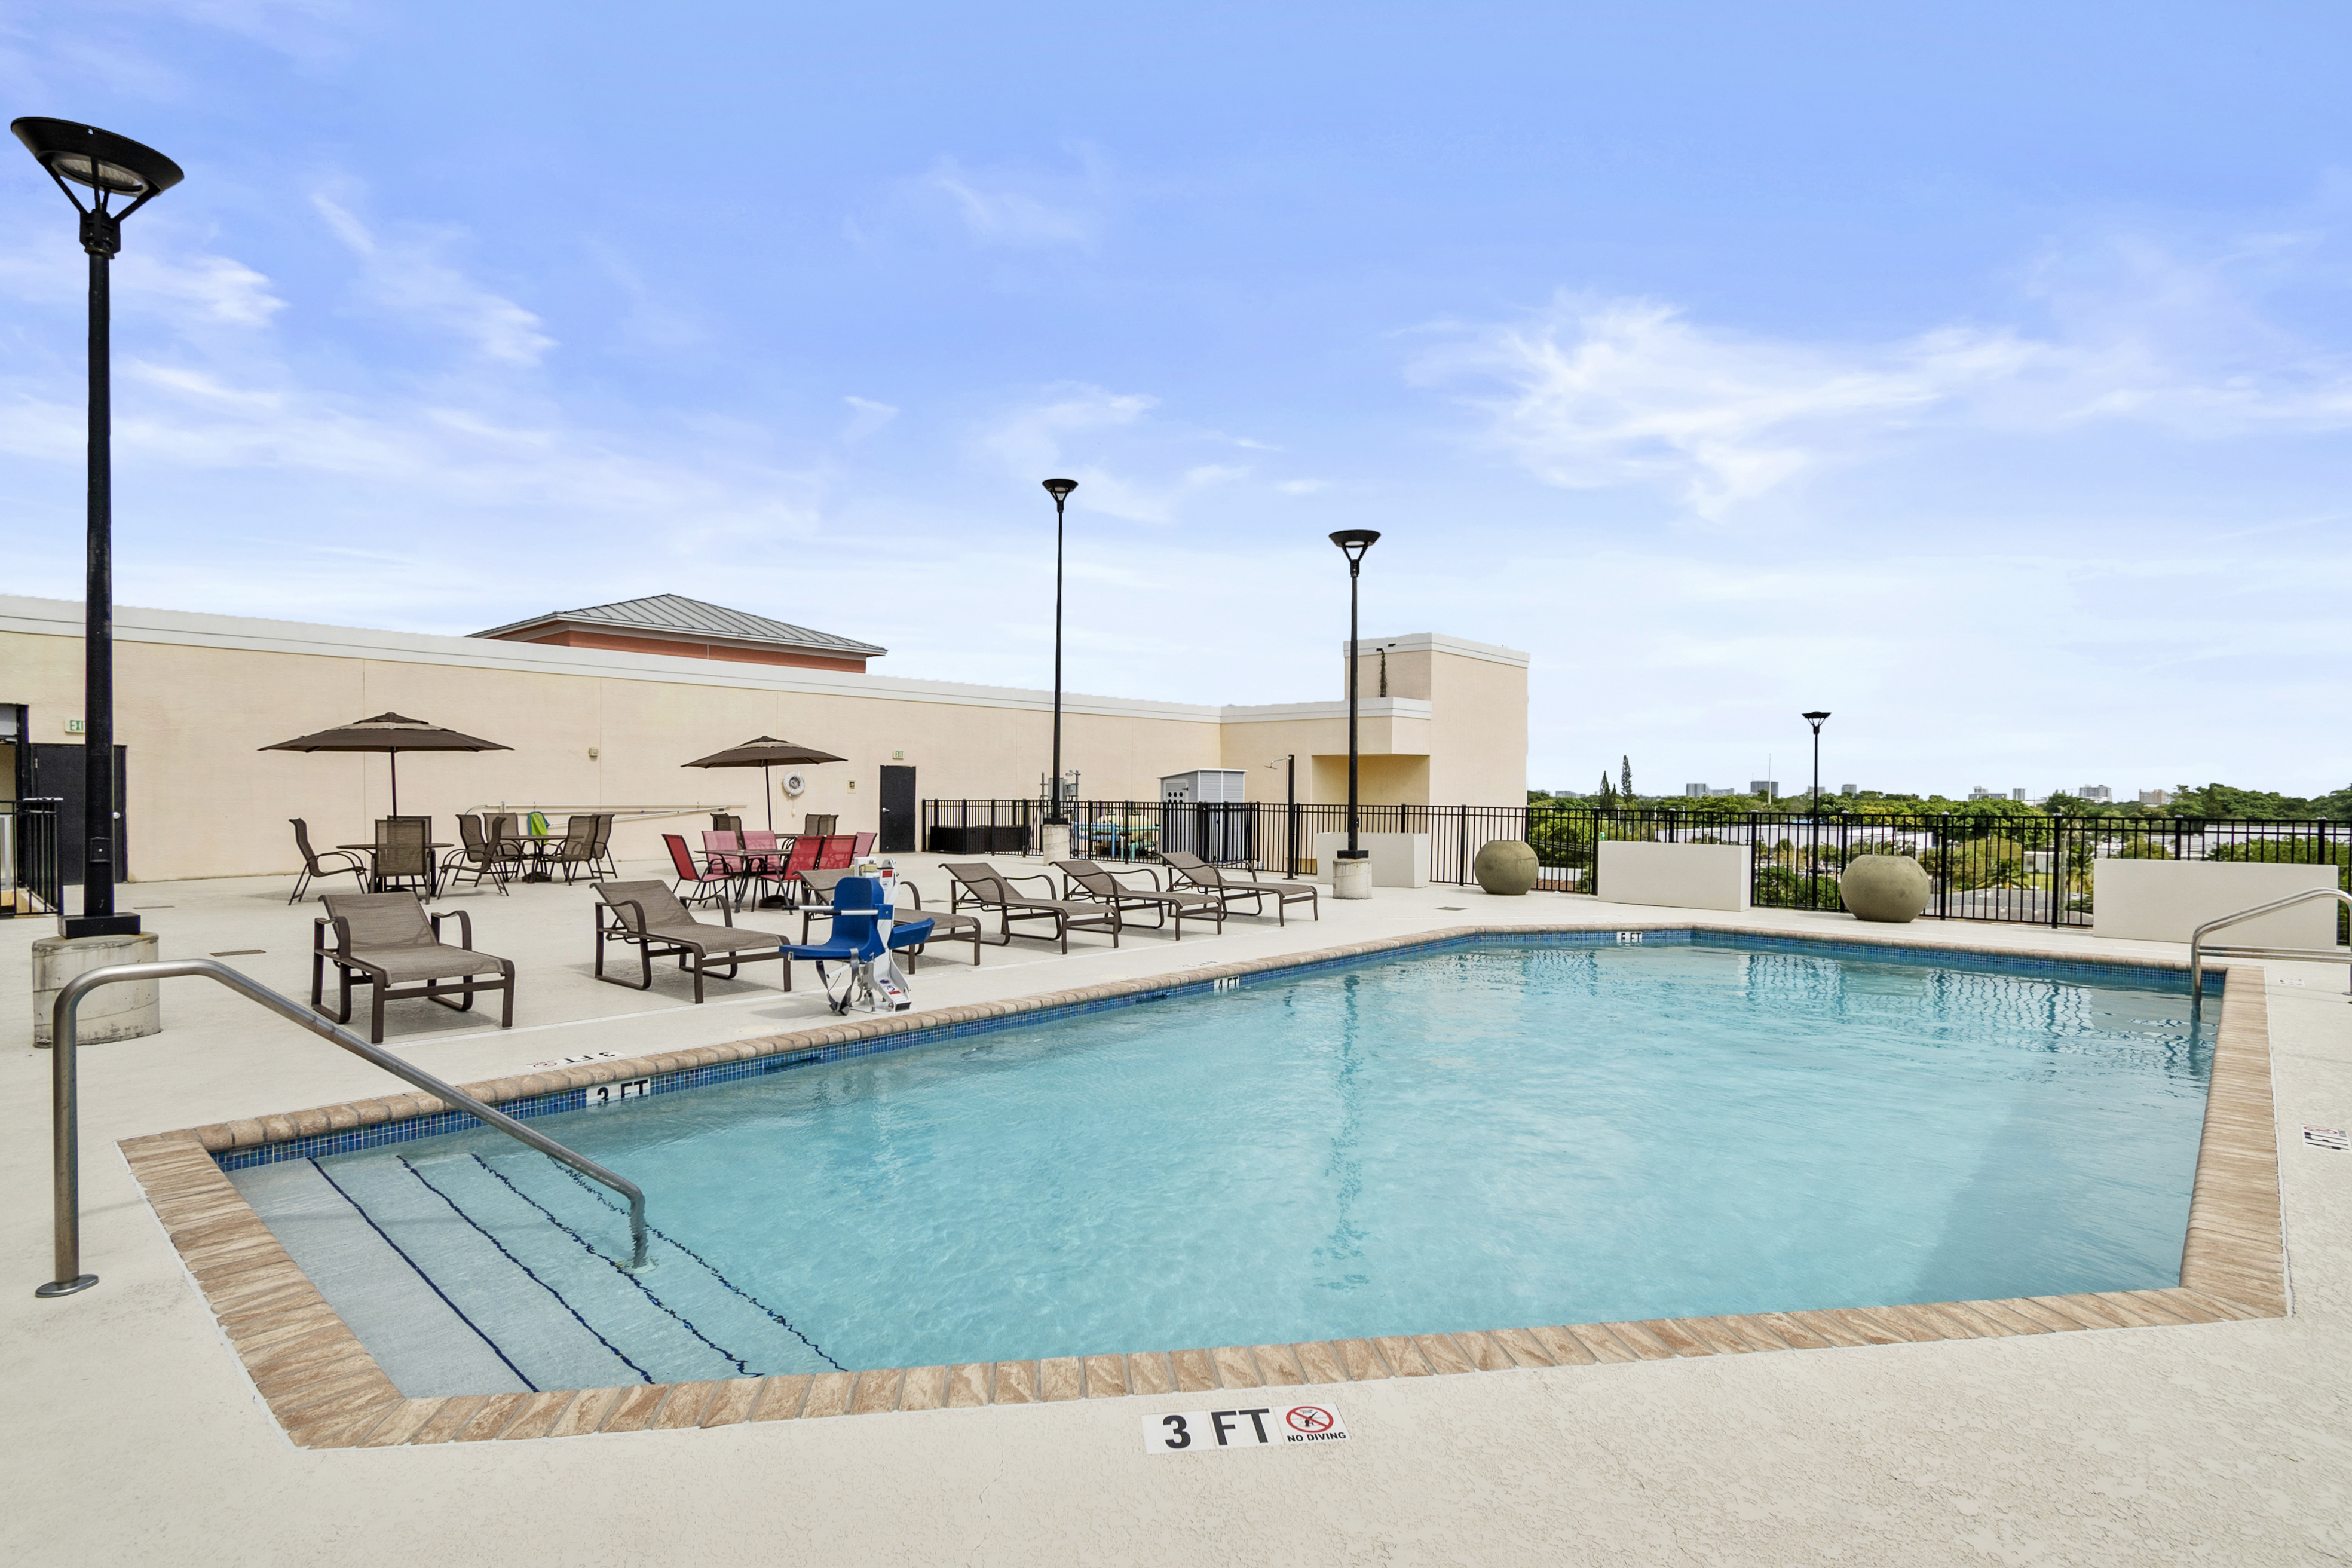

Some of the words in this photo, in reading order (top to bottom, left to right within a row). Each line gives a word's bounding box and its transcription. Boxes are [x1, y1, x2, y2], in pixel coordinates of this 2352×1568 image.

[69, 719, 85, 731] EXI
[620, 1079, 648, 1098] FT
[1162, 1415, 1192, 1449] 3
[1211, 1408, 1270, 1446] FT
[1287, 1434, 1304, 1443] NO
[1306, 1432, 1346, 1441] DIVING
